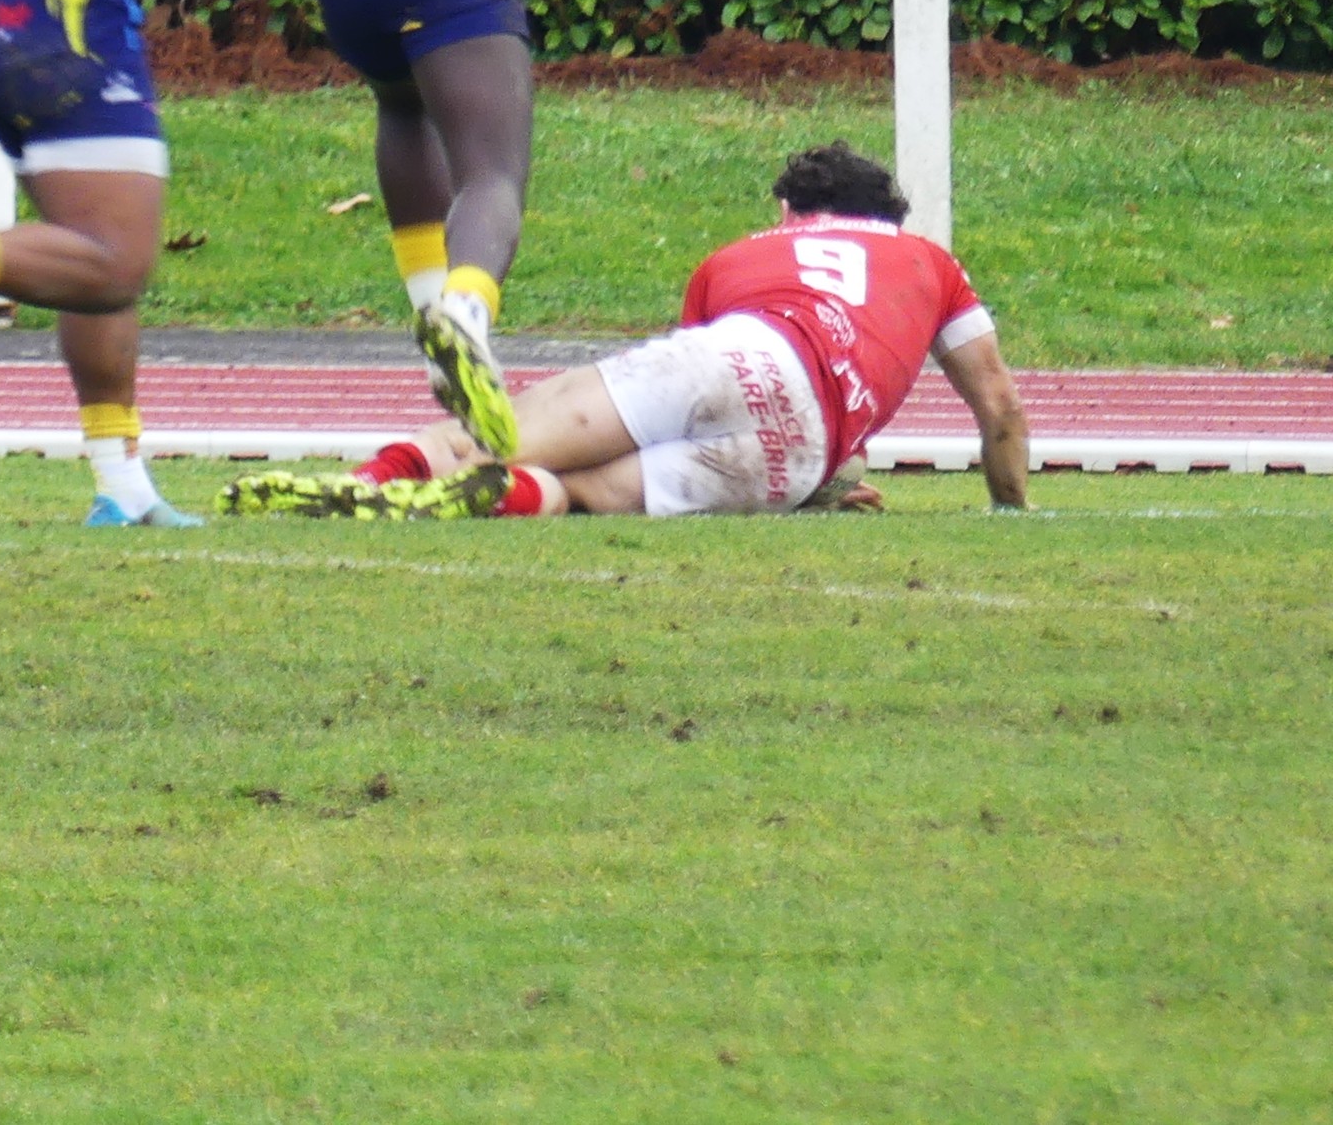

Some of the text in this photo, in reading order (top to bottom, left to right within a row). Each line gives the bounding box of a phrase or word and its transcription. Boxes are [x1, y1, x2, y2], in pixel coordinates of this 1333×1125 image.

[793, 238, 868, 306] 9
[720, 350, 790, 505] PARE-BRISE
[754, 350, 807, 448] FRANCE
